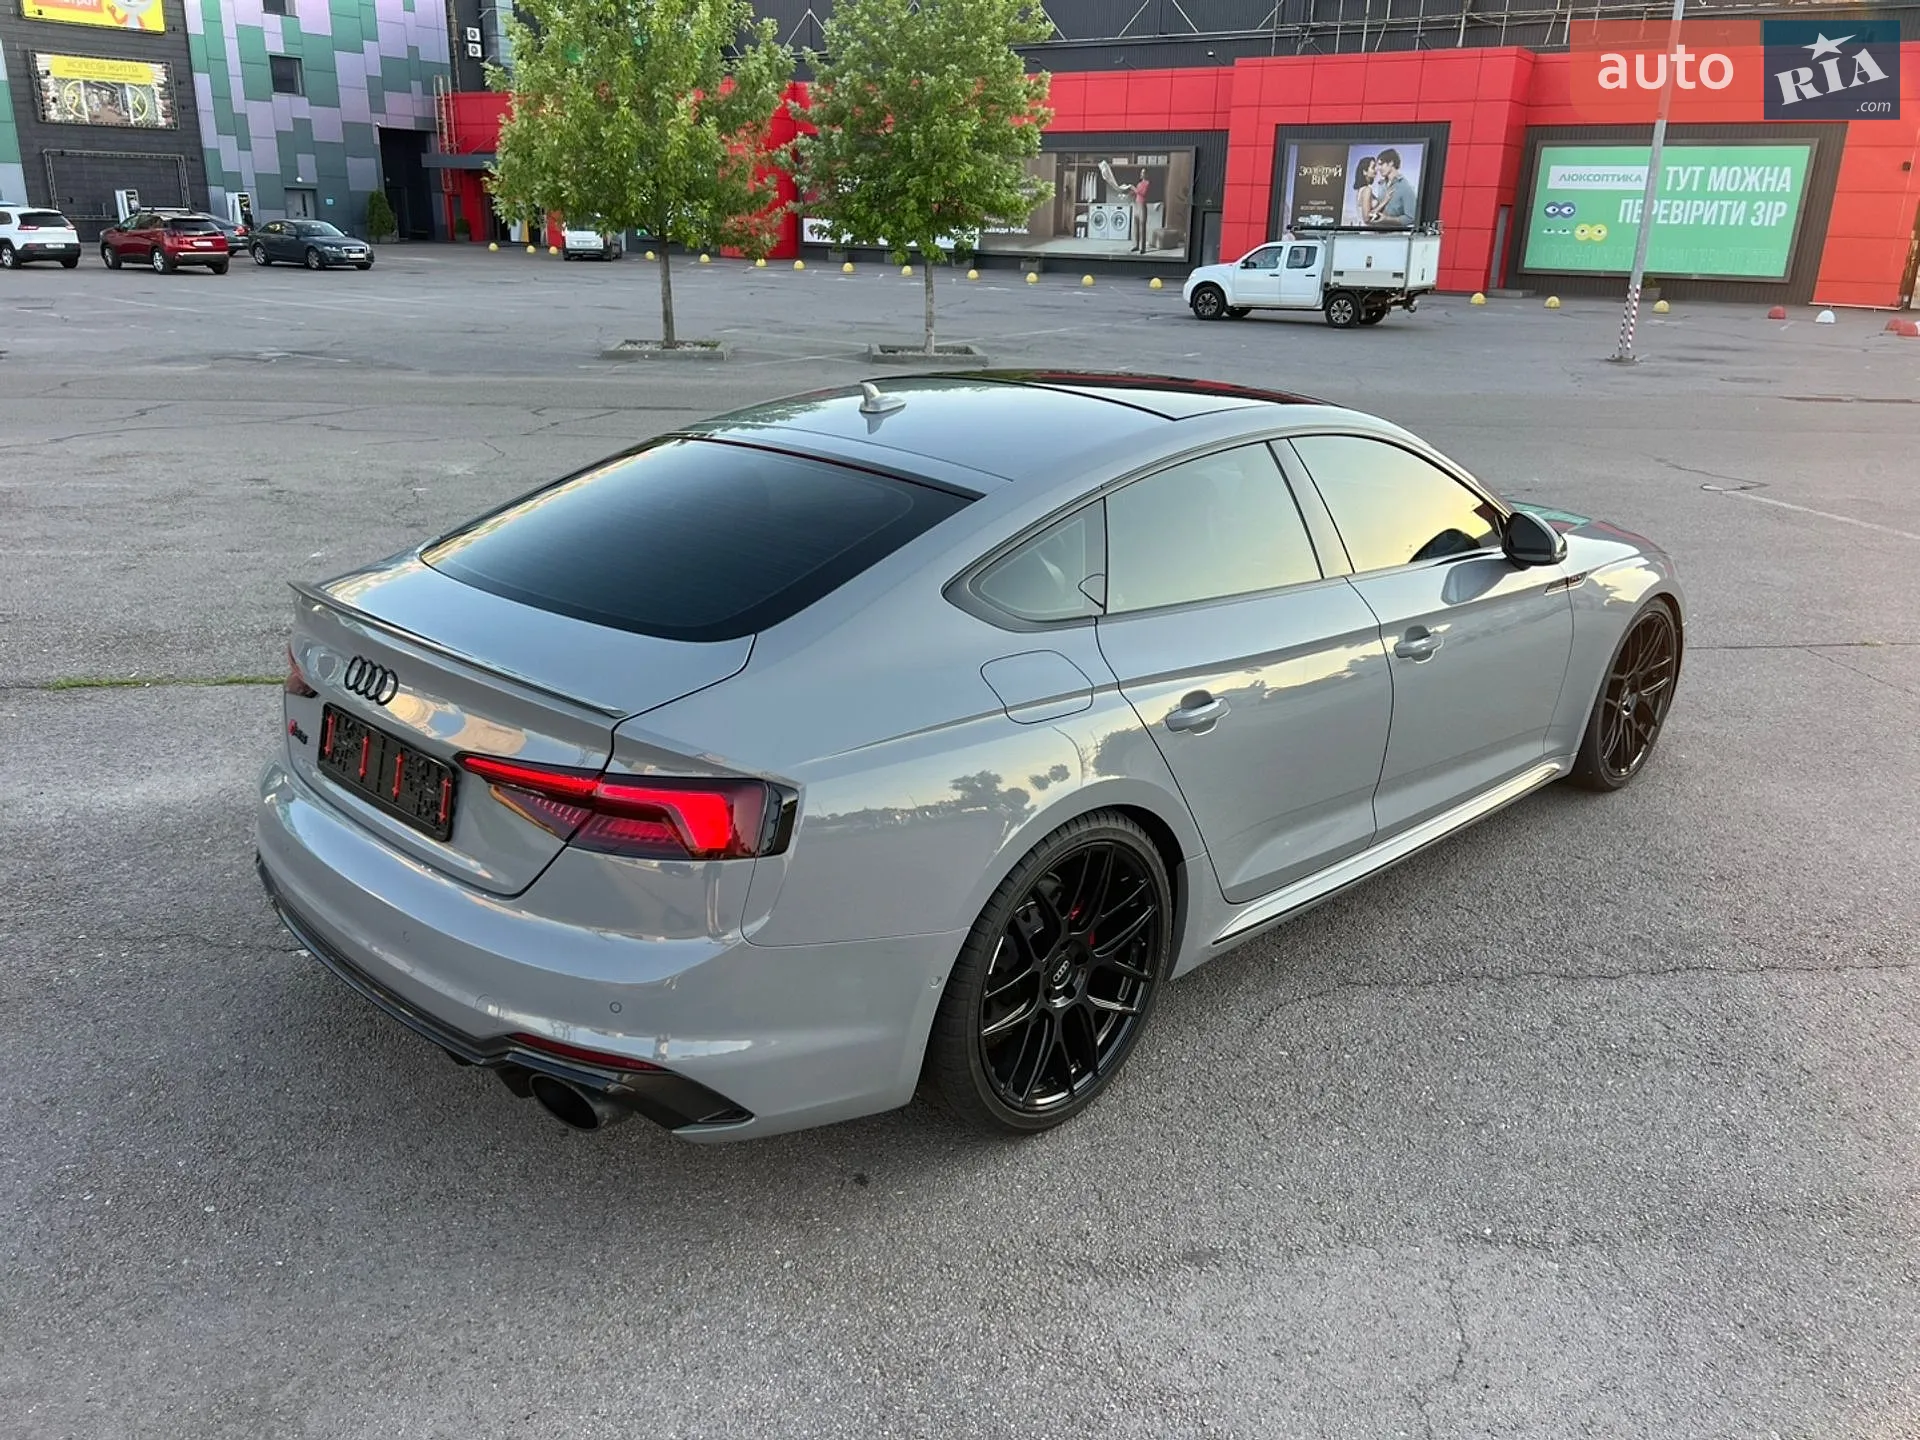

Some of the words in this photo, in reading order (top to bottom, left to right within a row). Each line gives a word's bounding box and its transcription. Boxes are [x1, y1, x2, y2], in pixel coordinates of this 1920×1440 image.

[1558, 173, 1643, 184] ЛЮКСОПТИКА
[1665, 166, 1704, 192] ТУТ
[1706, 166, 1791, 193] МОЖНА
[1750, 201, 1788, 227] ЗІР
